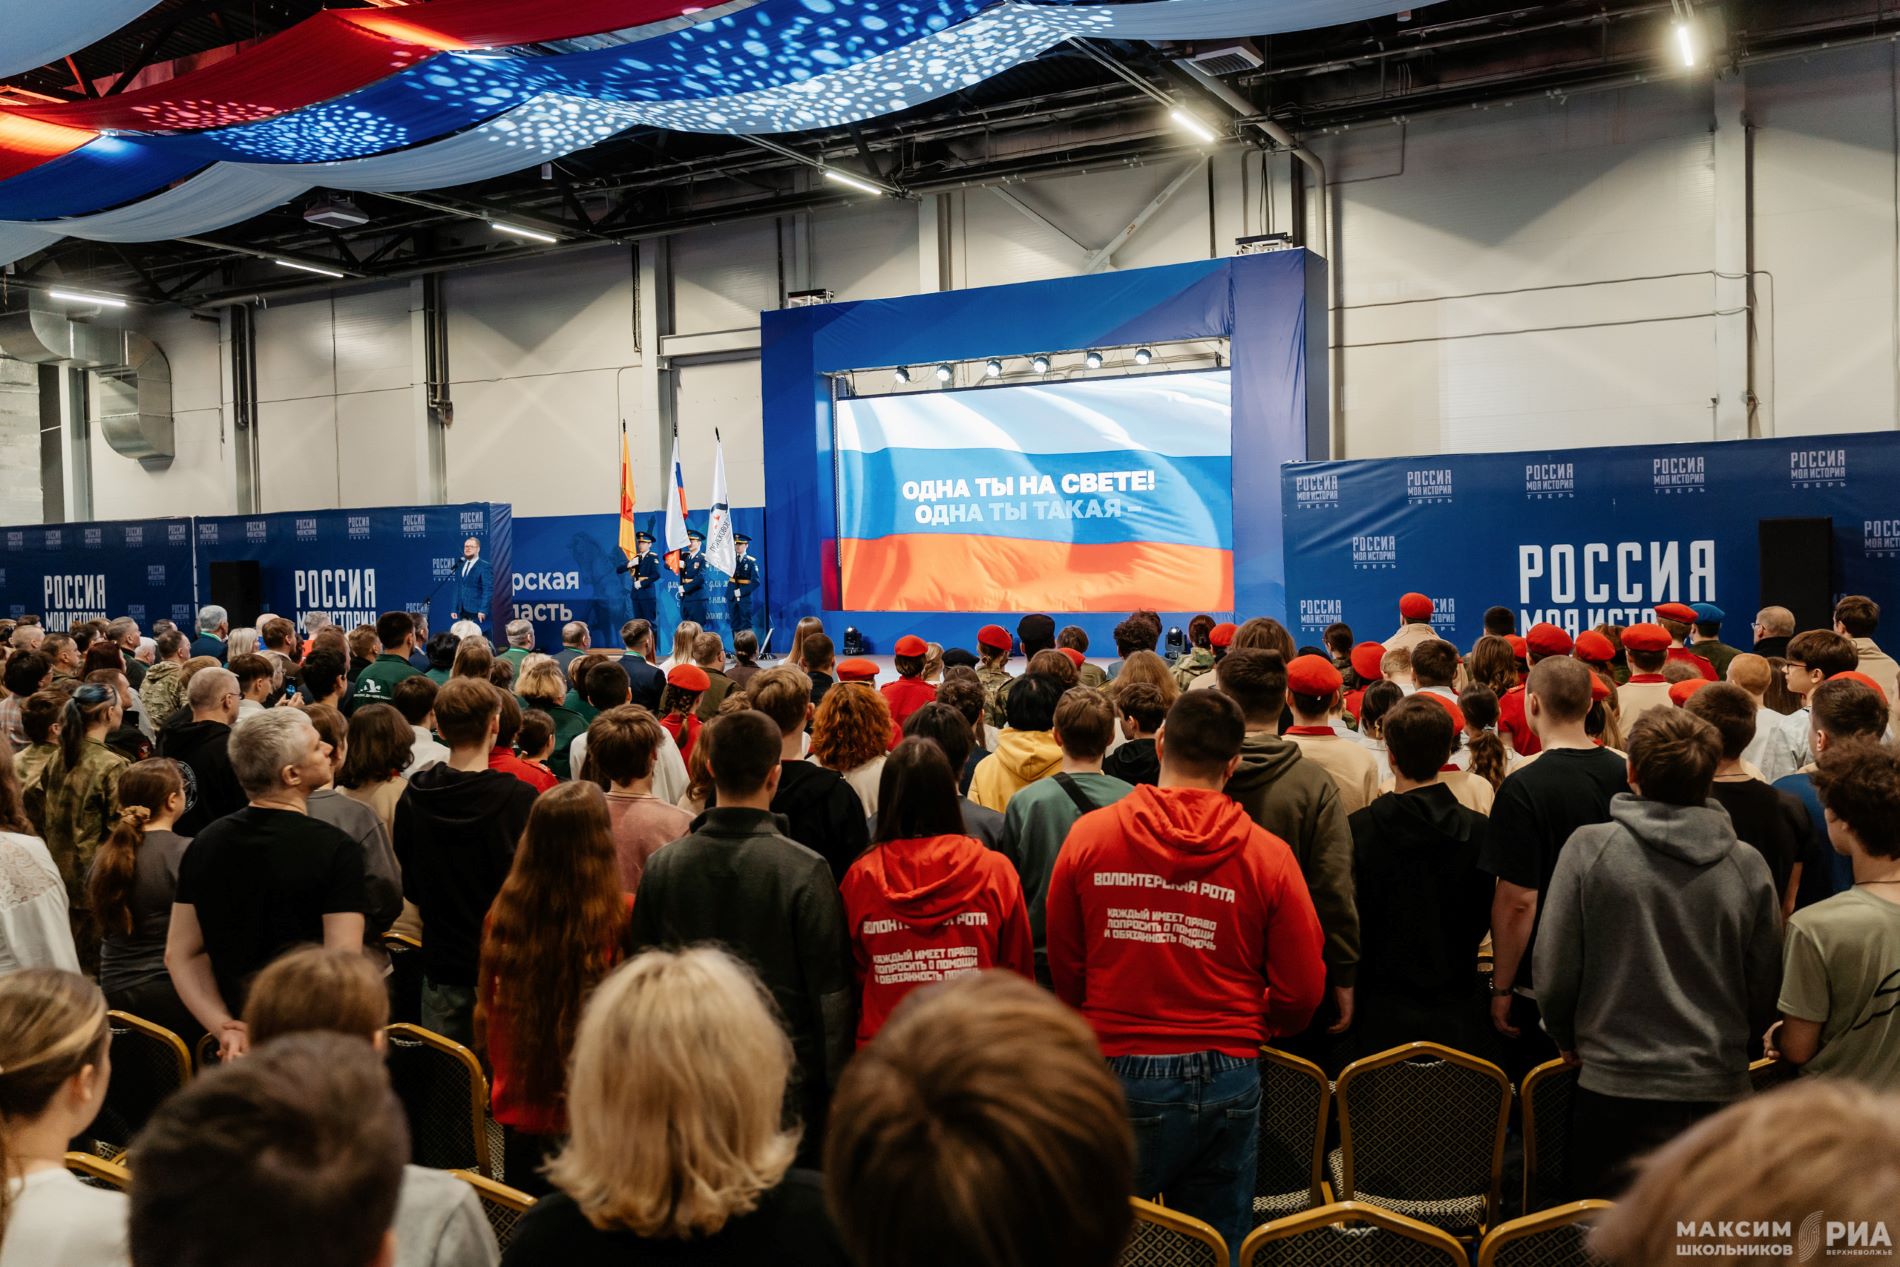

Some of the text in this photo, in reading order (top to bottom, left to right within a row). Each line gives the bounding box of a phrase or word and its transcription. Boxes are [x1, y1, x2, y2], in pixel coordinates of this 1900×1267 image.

[1653, 457, 1704, 474] РОССИЯ
[1791, 450, 1845, 468] РОССИЯ
[1407, 470, 1452, 486] РОССИЯ
[1526, 463, 1573, 480] РОССИЯ
[1654, 473, 1704, 485] МОЯ ИСТОРИЯ
[1791, 467, 1845, 479] МОЯ ИСТОРИЯ
[902, 470, 1155, 502] ОДНА ТЫ НА СВЕТЕ!
[1296, 475, 1338, 491] РОССИЯ
[1407, 485, 1452, 496] МОЯ ИСТОРИЯ
[1526, 479, 1573, 490] МОЯ ИСТОРИЯ
[1296, 491, 1338, 501] МОЯ ИСТОРИЯ
[403, 514, 425, 525] РОССИЯ
[460, 512, 483, 523] РОССИЯ
[915, 503, 984, 526] ОДНА
[989, 502, 1027, 521] ТЫ
[1033, 498, 1121, 521] ТАКАЯ
[1353, 536, 1396, 551] РОССИЯ
[1353, 551, 1396, 560] МОЯ ИСТОРИЯ
[1519, 540, 1716, 604] РОССИЯ
[295, 569, 376, 608] РОССИЯ
[512, 571, 580, 597] рская
[44, 575, 106, 609] РОССИЯ
[1300, 600, 1341, 614] РОССИЯ
[1433, 598, 1455, 613] СИЯ
[45, 612, 106, 632] МОЯ ИСТО
[1301, 614, 1341, 624] МОЯ ИСТОРИЯ
[1431, 614, 1455, 623] СТОРИЯ
[1200, 883, 1236, 903] РОТА
[957, 912, 988, 926] РОТА
[1107, 908, 1217, 931] КАЖДЫЙ ИМЕЕТ ПРАВО
[1107, 919, 1214, 941] ПОПРОСИТЬ О ПОМОЩИ
[1113, 930, 1177, 944] ОБЯЗАННОСТЬ
[1179, 935, 1216, 951] ПОМОЧЬ
[914, 948, 946, 960] ИМЕЕТ
[947, 947, 978, 958] ПРАВО
[928, 960, 935, 970] О
[936, 957, 978, 970] ПОМОЩИ
[879, 971, 943, 985] ОБЯЗАННОСТЬ
